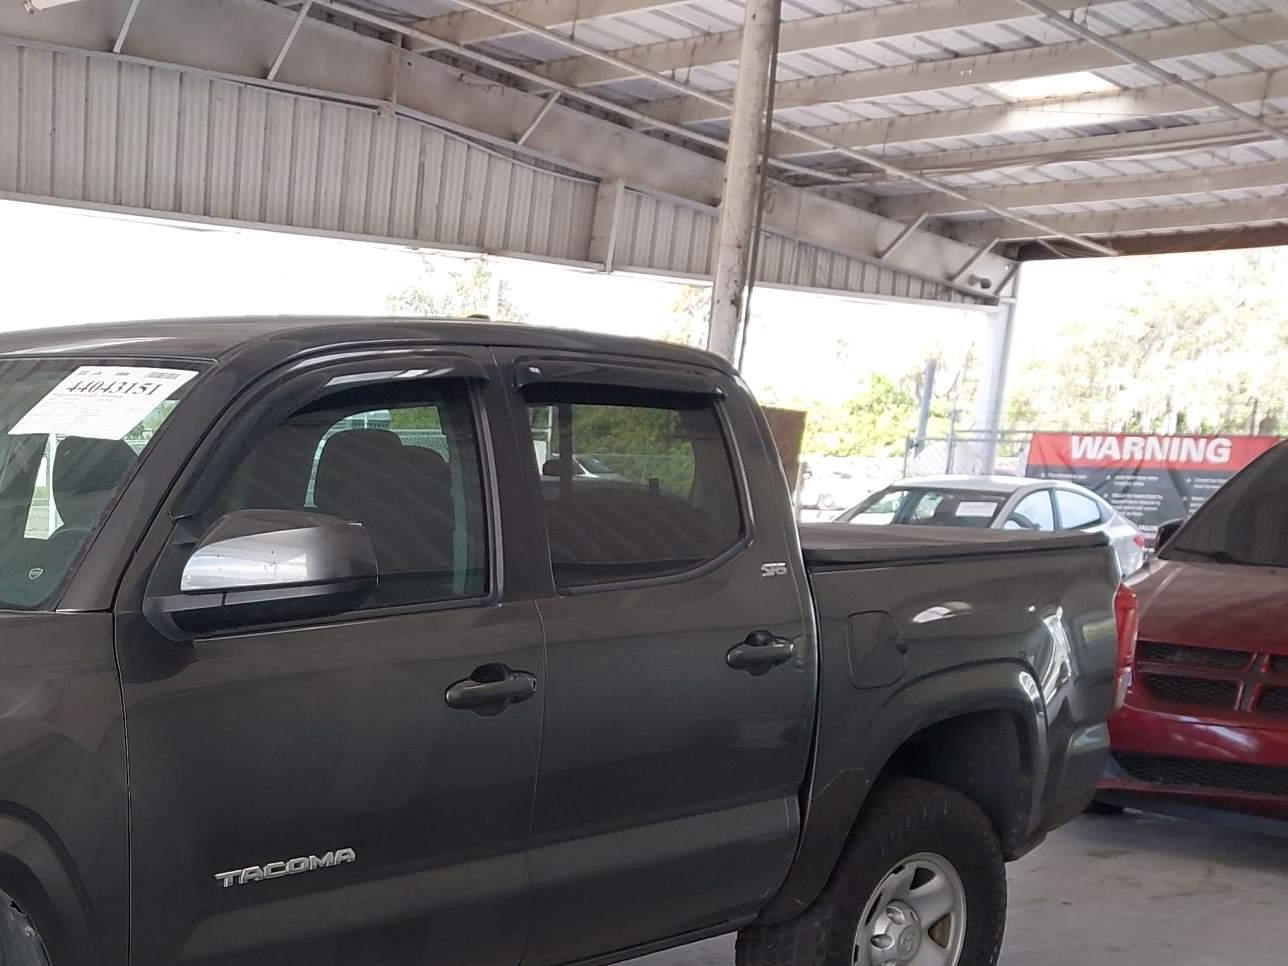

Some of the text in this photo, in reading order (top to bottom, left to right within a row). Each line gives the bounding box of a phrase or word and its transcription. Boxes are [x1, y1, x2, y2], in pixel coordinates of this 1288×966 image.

[66, 381, 162, 395] 44043151
[1070, 435, 1231, 463] WARNING
[214, 848, 356, 887] TACOMA
